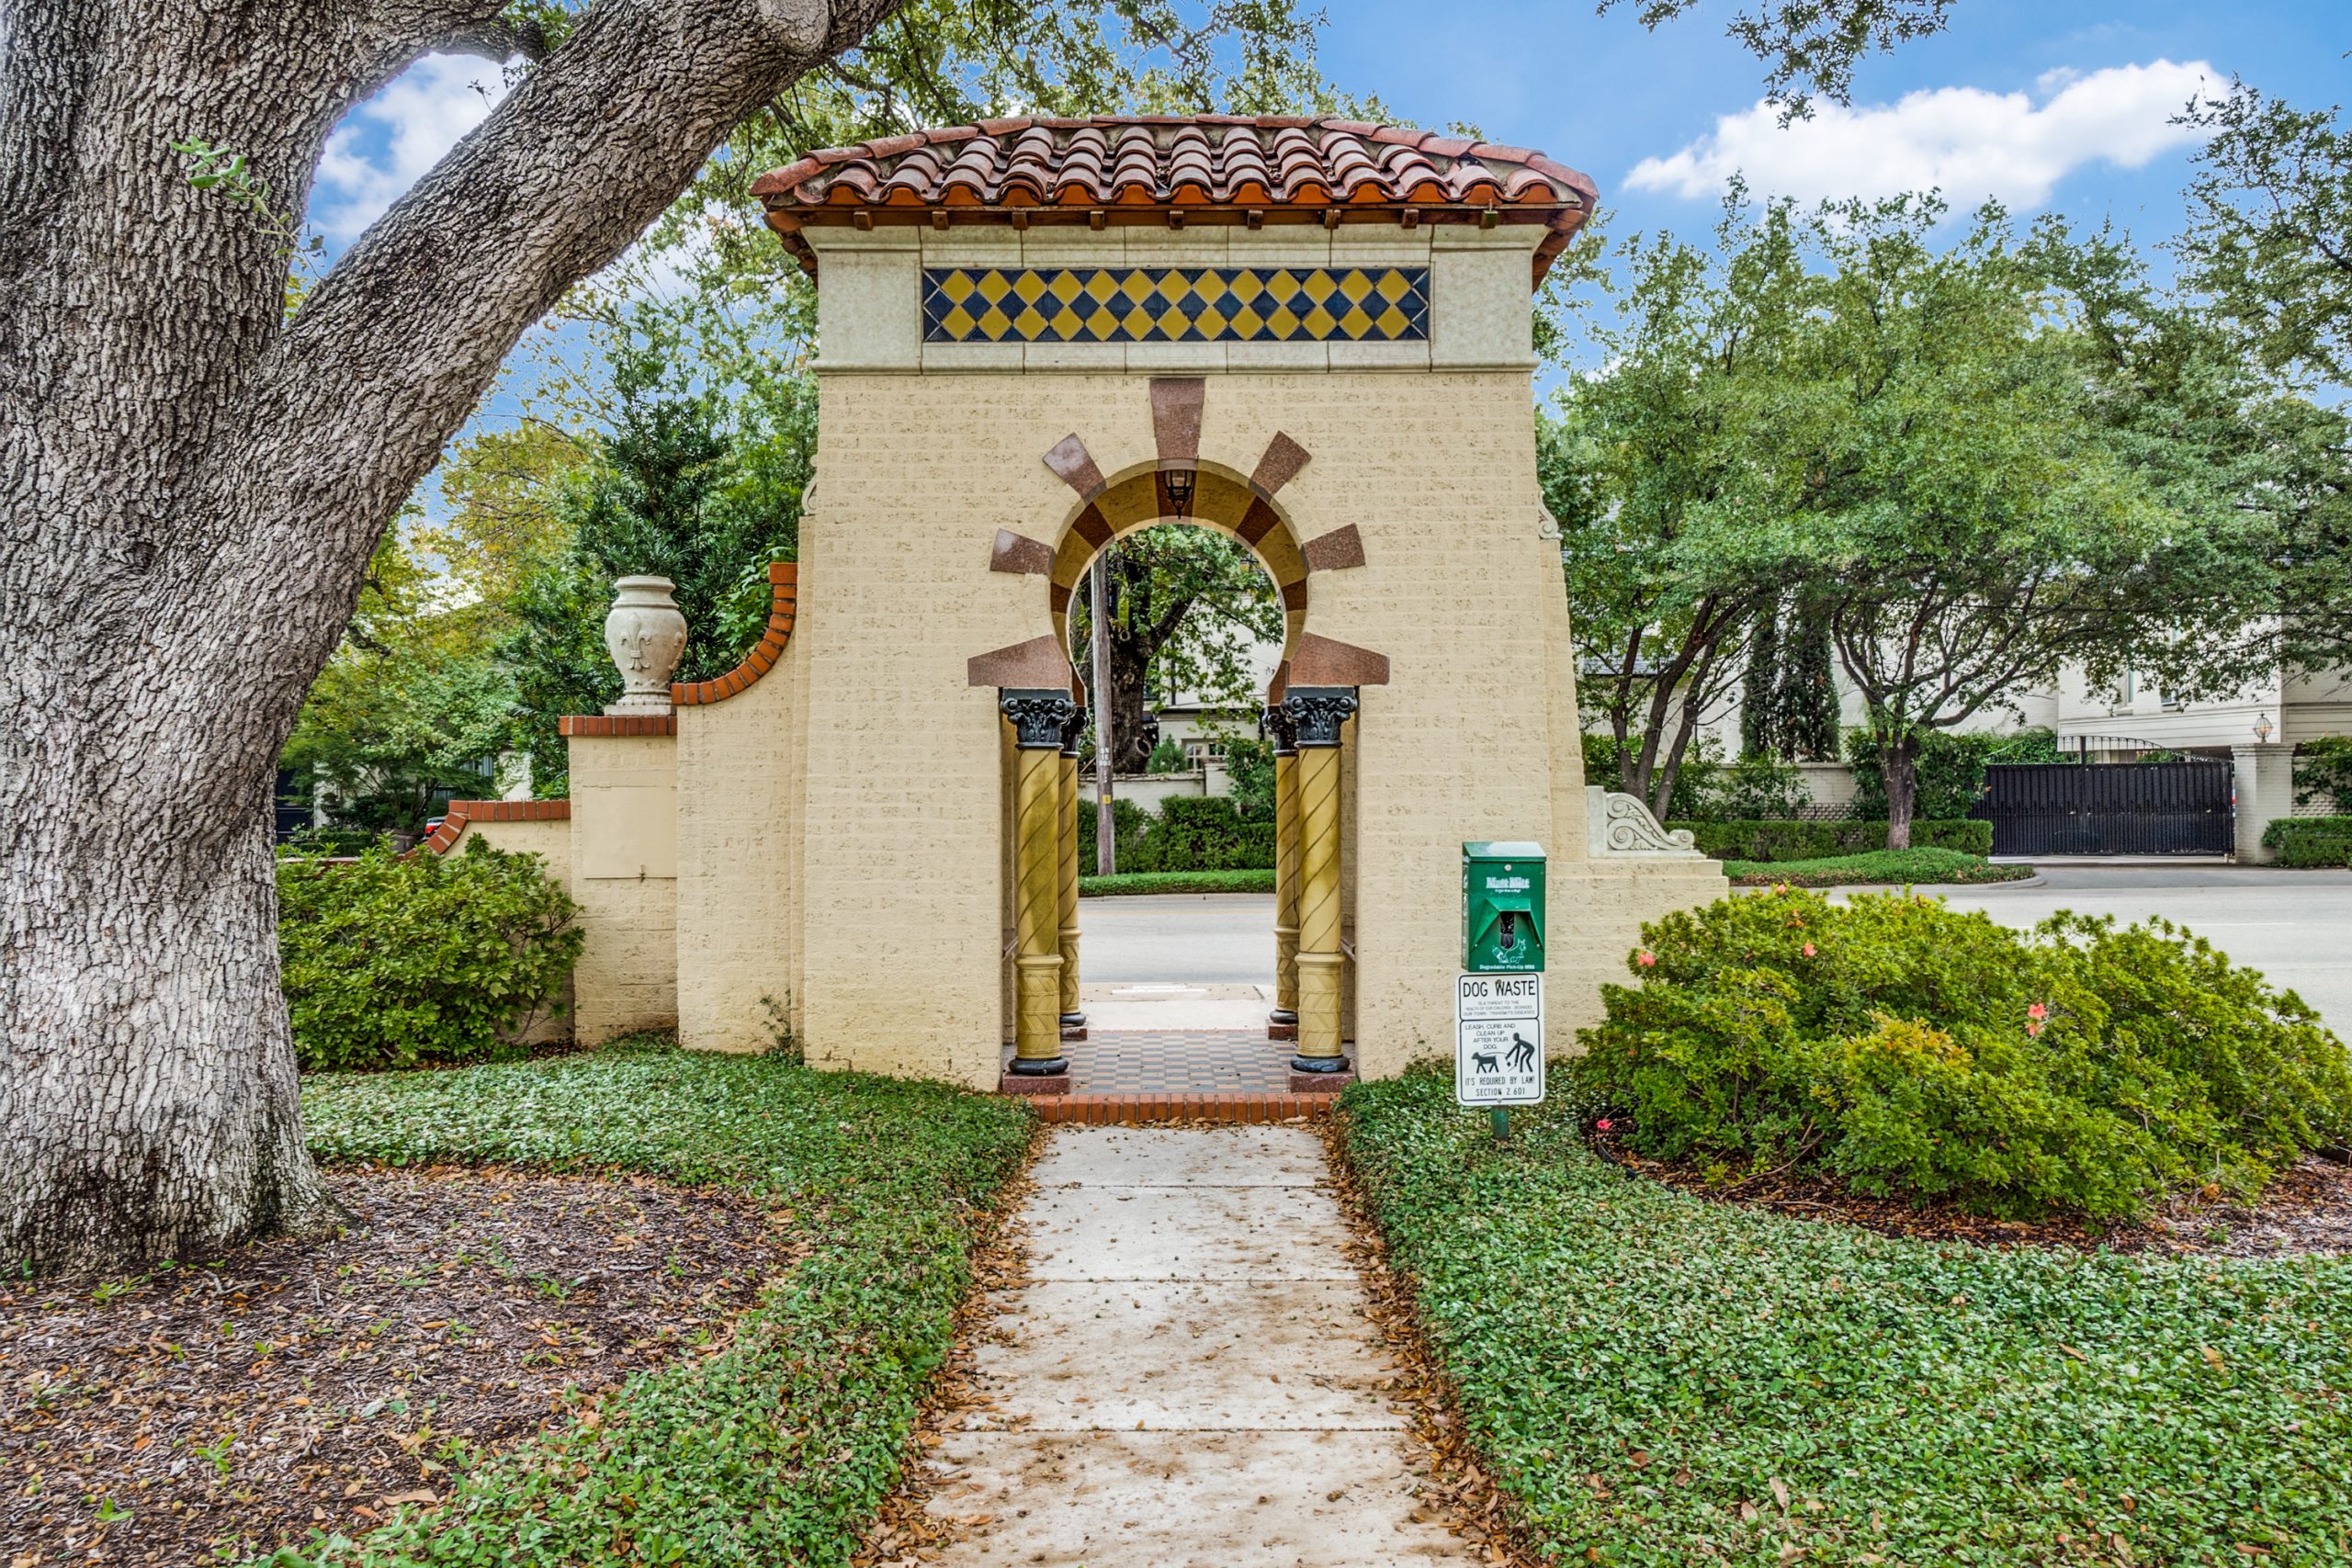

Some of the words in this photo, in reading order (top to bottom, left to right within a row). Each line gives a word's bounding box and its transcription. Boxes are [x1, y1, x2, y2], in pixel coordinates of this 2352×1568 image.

[1463, 981, 1487, 997] DOG
[1495, 980, 1535, 997] WASTE
[1464, 1077, 1475, 1086] IT'S
[1479, 1077, 1505, 1085] REQUIRED
[1521, 1076, 1535, 1084] LAW!
